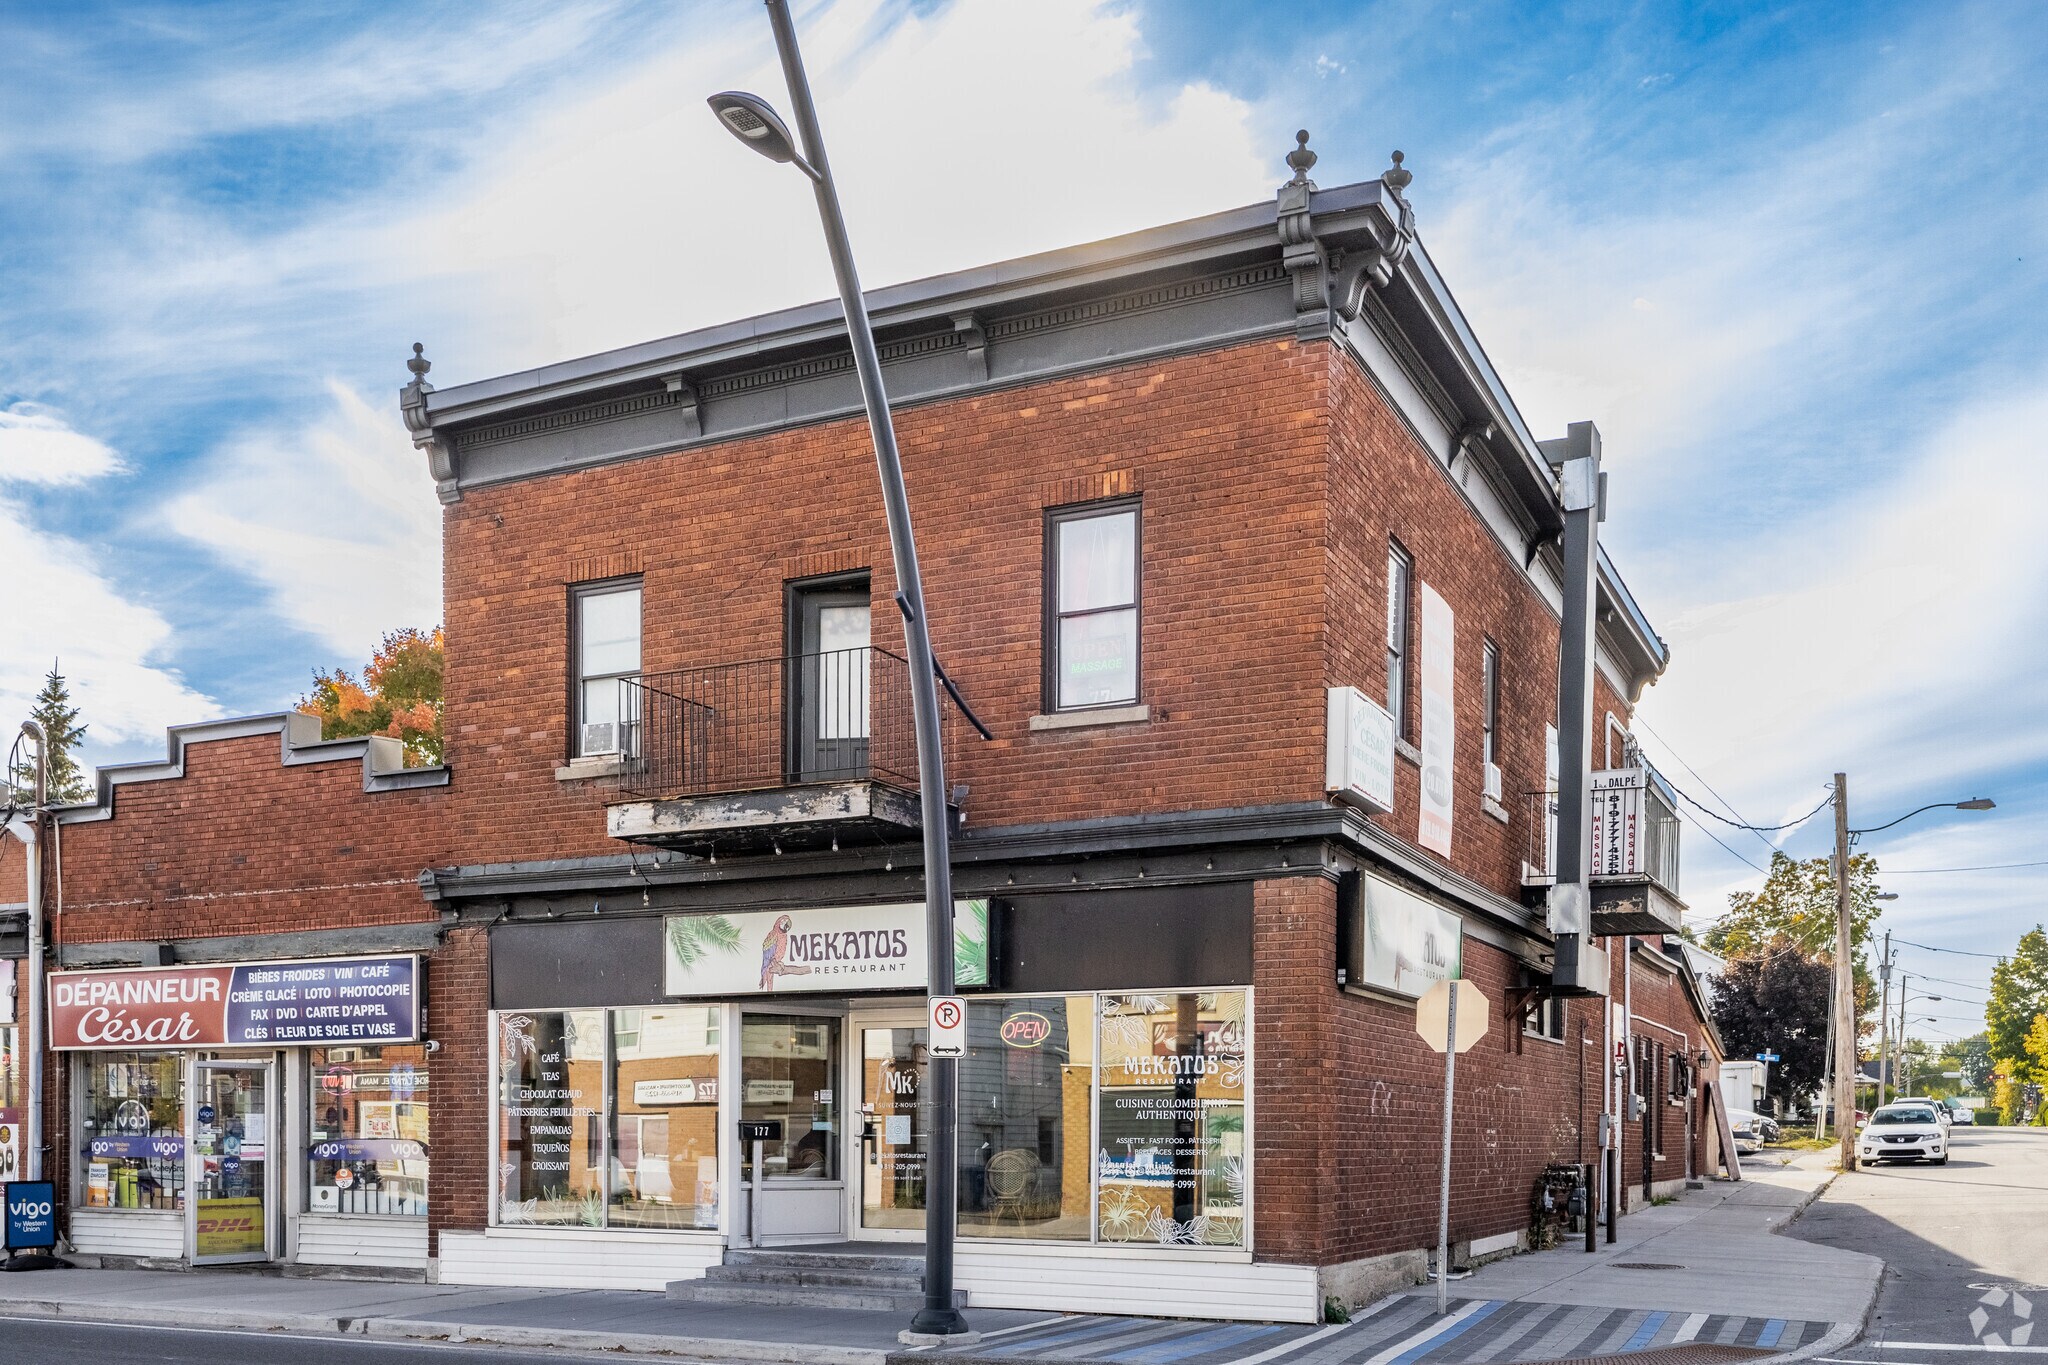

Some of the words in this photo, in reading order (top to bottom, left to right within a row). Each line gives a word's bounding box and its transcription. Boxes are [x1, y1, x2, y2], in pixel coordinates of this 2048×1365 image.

[1071, 658, 1123, 674] MASSAGE
[1608, 774, 1637, 788] DALPÉ
[789, 929, 908, 962] MEKATOS
[248, 968, 280, 984] BIÈRES
[282, 969, 325, 982] FROIDES
[334, 967, 353, 980] VIN
[361, 962, 390, 978] CAFÉ
[814, 963, 906, 975] RESTAURANT
[56, 977, 221, 1007] DÉPANNEUR
[231, 988, 263, 1003] CRÈME
[265, 986, 297, 1002] GLACÉ
[304, 987, 331, 1000] LOTO
[340, 983, 410, 998] PHOTOCOPIE
[251, 1008, 268, 1021] FAX
[276, 1007, 298, 1020] DVD
[305, 1005, 340, 1018] CARTE
[342, 1004, 388, 1017] D'APPEL
[943, 1008, 953, 1022] P
[77, 1007, 200, 1043] César
[244, 1025, 268, 1039] CLÉS
[276, 1026, 307, 1038] FLEUR
[308, 1025, 323, 1037] DE
[325, 1025, 350, 1037] SOIE
[352, 1024, 365, 1036] ET
[366, 1023, 396, 1035] VASE
[1003, 1021, 1046, 1039] OPEN
[541, 1051, 560, 1063] CAFÉ
[1123, 1055, 1219, 1075] MEKATOS
[541, 1072, 560, 1081] TEAS
[1135, 1077, 1207, 1085] RESTAURANT
[520, 1089, 557, 1099] CHOCOLAT
[557, 1089, 583, 1099] CHAUD
[1115, 1098, 1153, 1109] CUISINE
[200, 1110, 214, 1118] vigo
[508, 1106, 549, 1116] PÂTISSERIES
[1135, 1110, 1207, 1121] AUTHENTIQUE
[119, 1115, 146, 1129] vgo
[530, 1125, 572, 1135] EMPANADAS
[754, 1126, 769, 1137] 177
[153, 1139, 178, 1155] vigo
[339, 1143, 346, 1151] by
[391, 1143, 420, 1158] vigo
[532, 1142, 570, 1154] TEQUEÑOS
[1175, 1148, 1209, 1156] DESSERTS
[224, 1161, 239, 1170] vigo
[531, 1161, 570, 1171] CROISSANT
[10, 1198, 52, 1219] vigo
[14, 1221, 22, 1229] by
[197, 1217, 256, 1233] DHL
